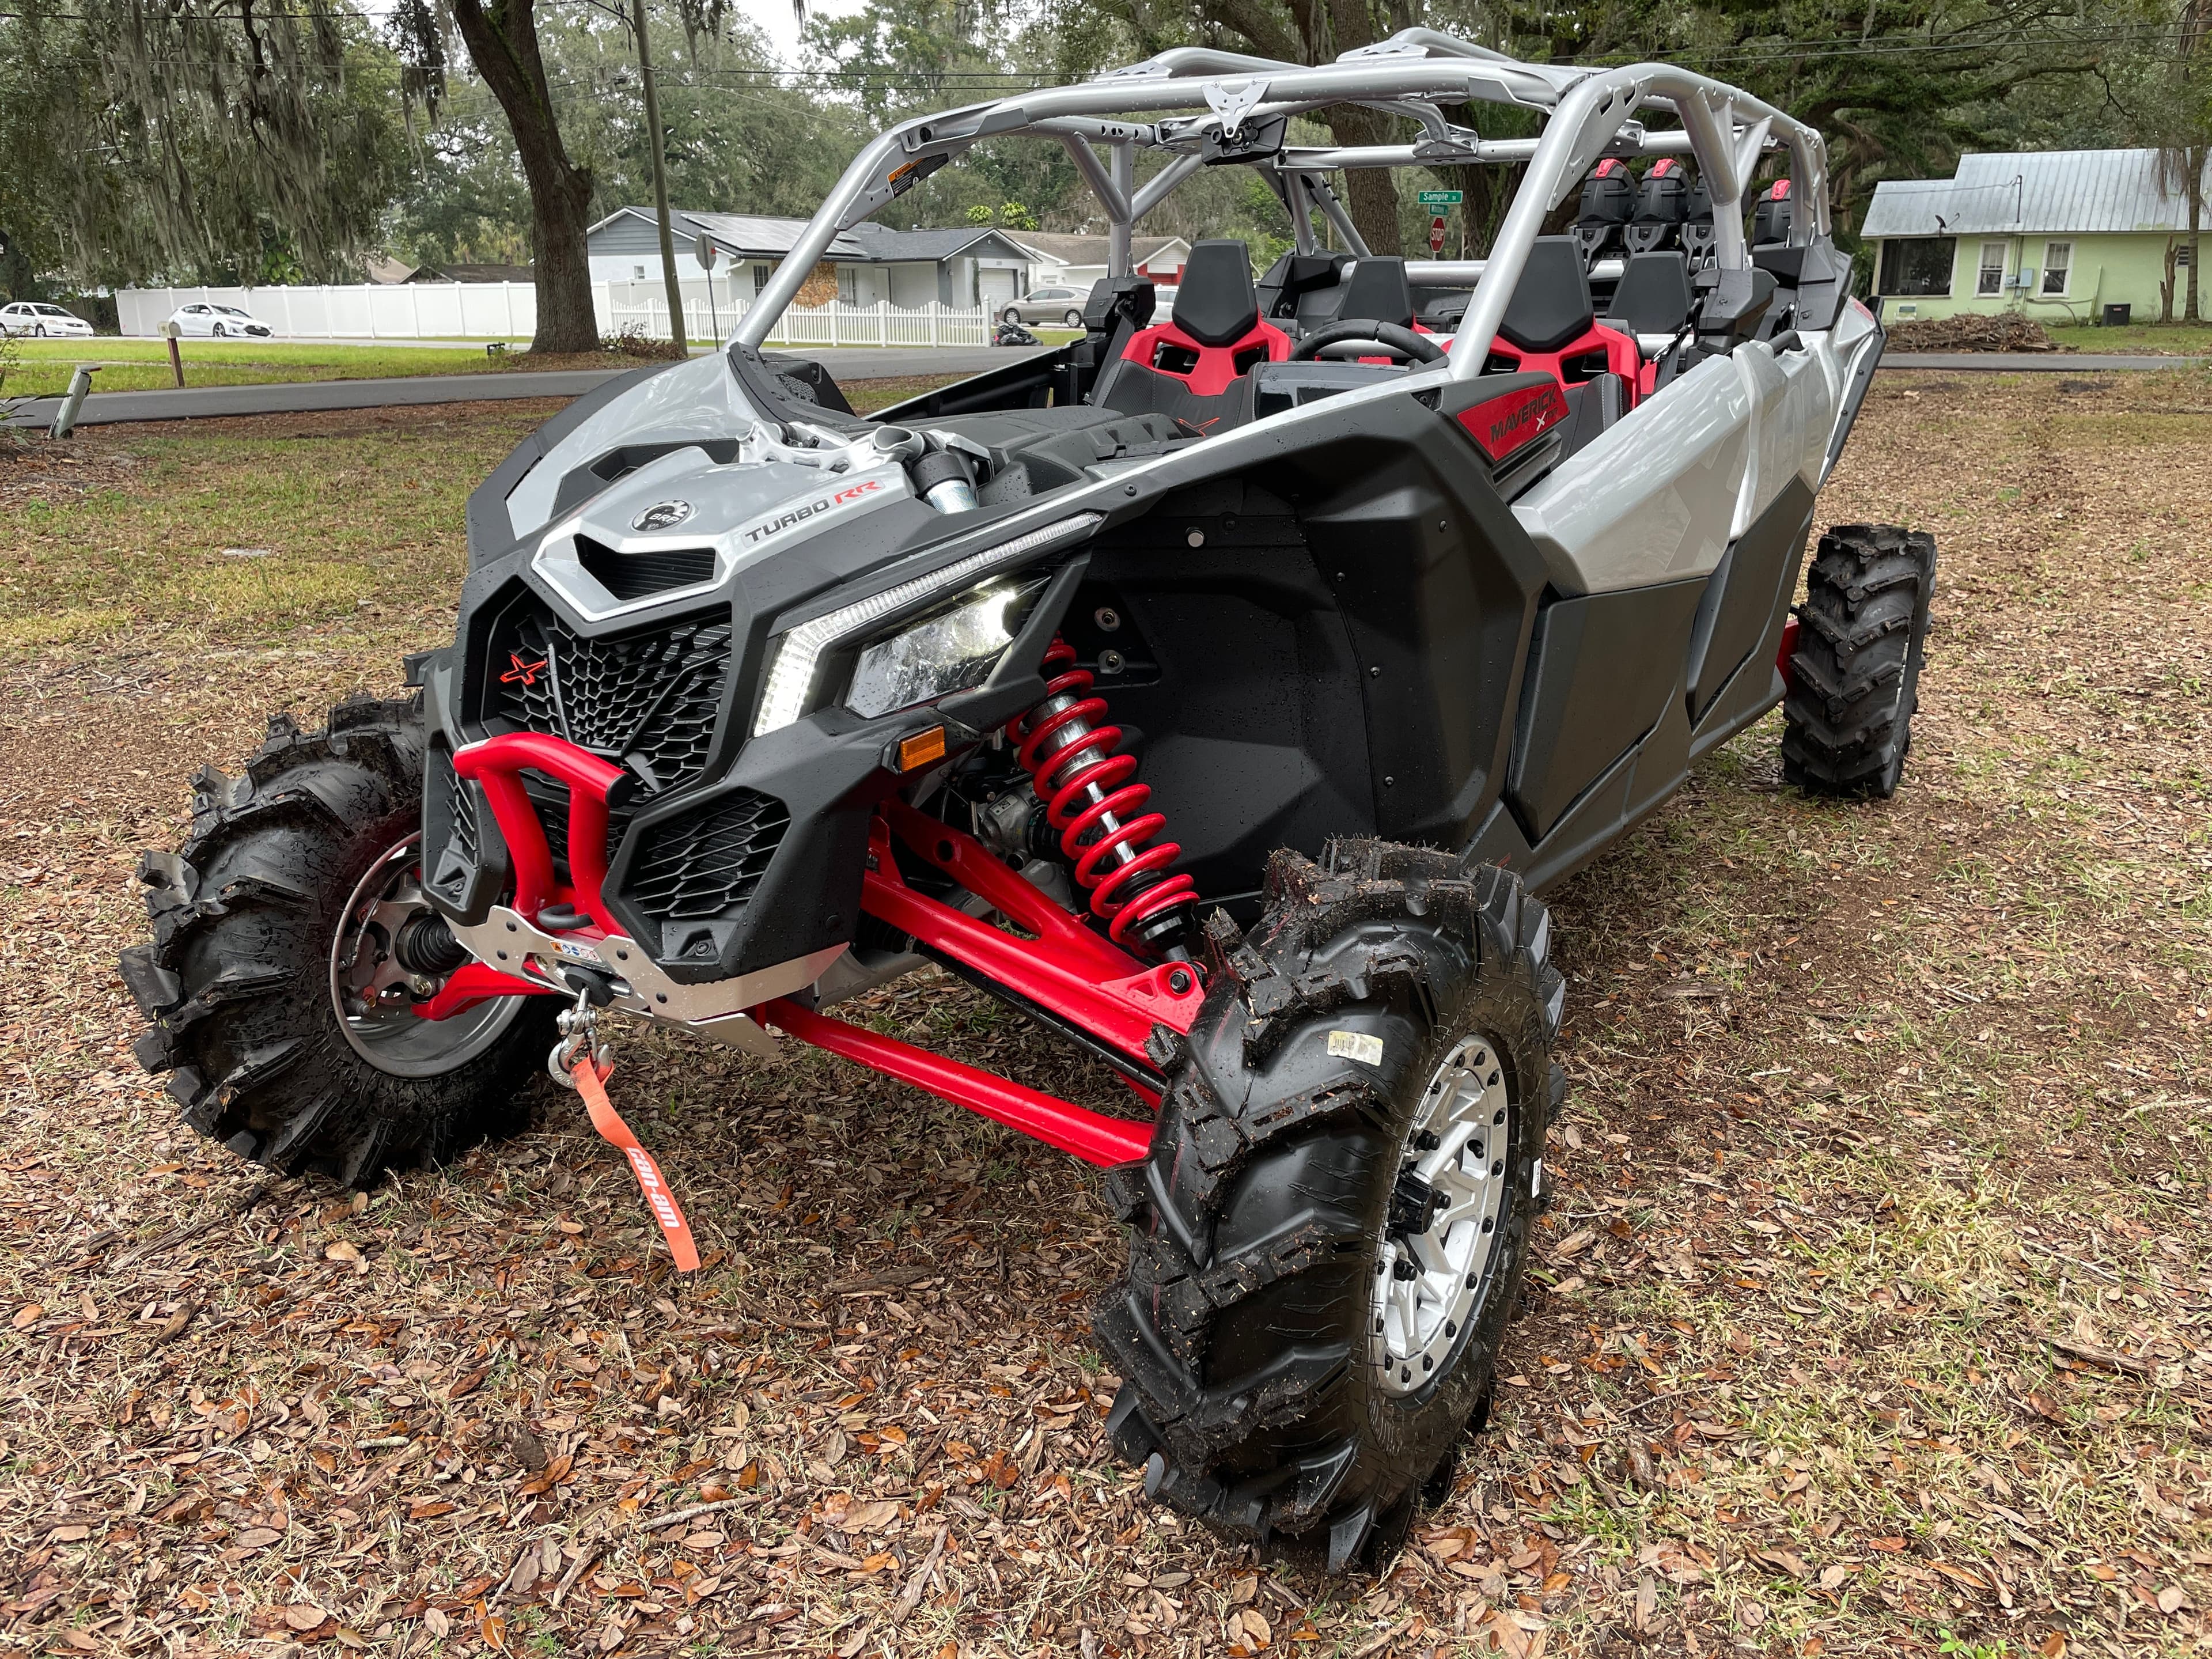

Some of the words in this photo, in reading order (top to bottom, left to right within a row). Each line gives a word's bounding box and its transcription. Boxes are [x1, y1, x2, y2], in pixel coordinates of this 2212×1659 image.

[1423, 192, 1449, 202] Sample
[1431, 227, 1445, 242] STOP
[1490, 386, 1557, 444] MAVERICK
[648, 513, 680, 522] BRP
[745, 499, 830, 542] TURBO
[834, 481, 882, 505] RR
